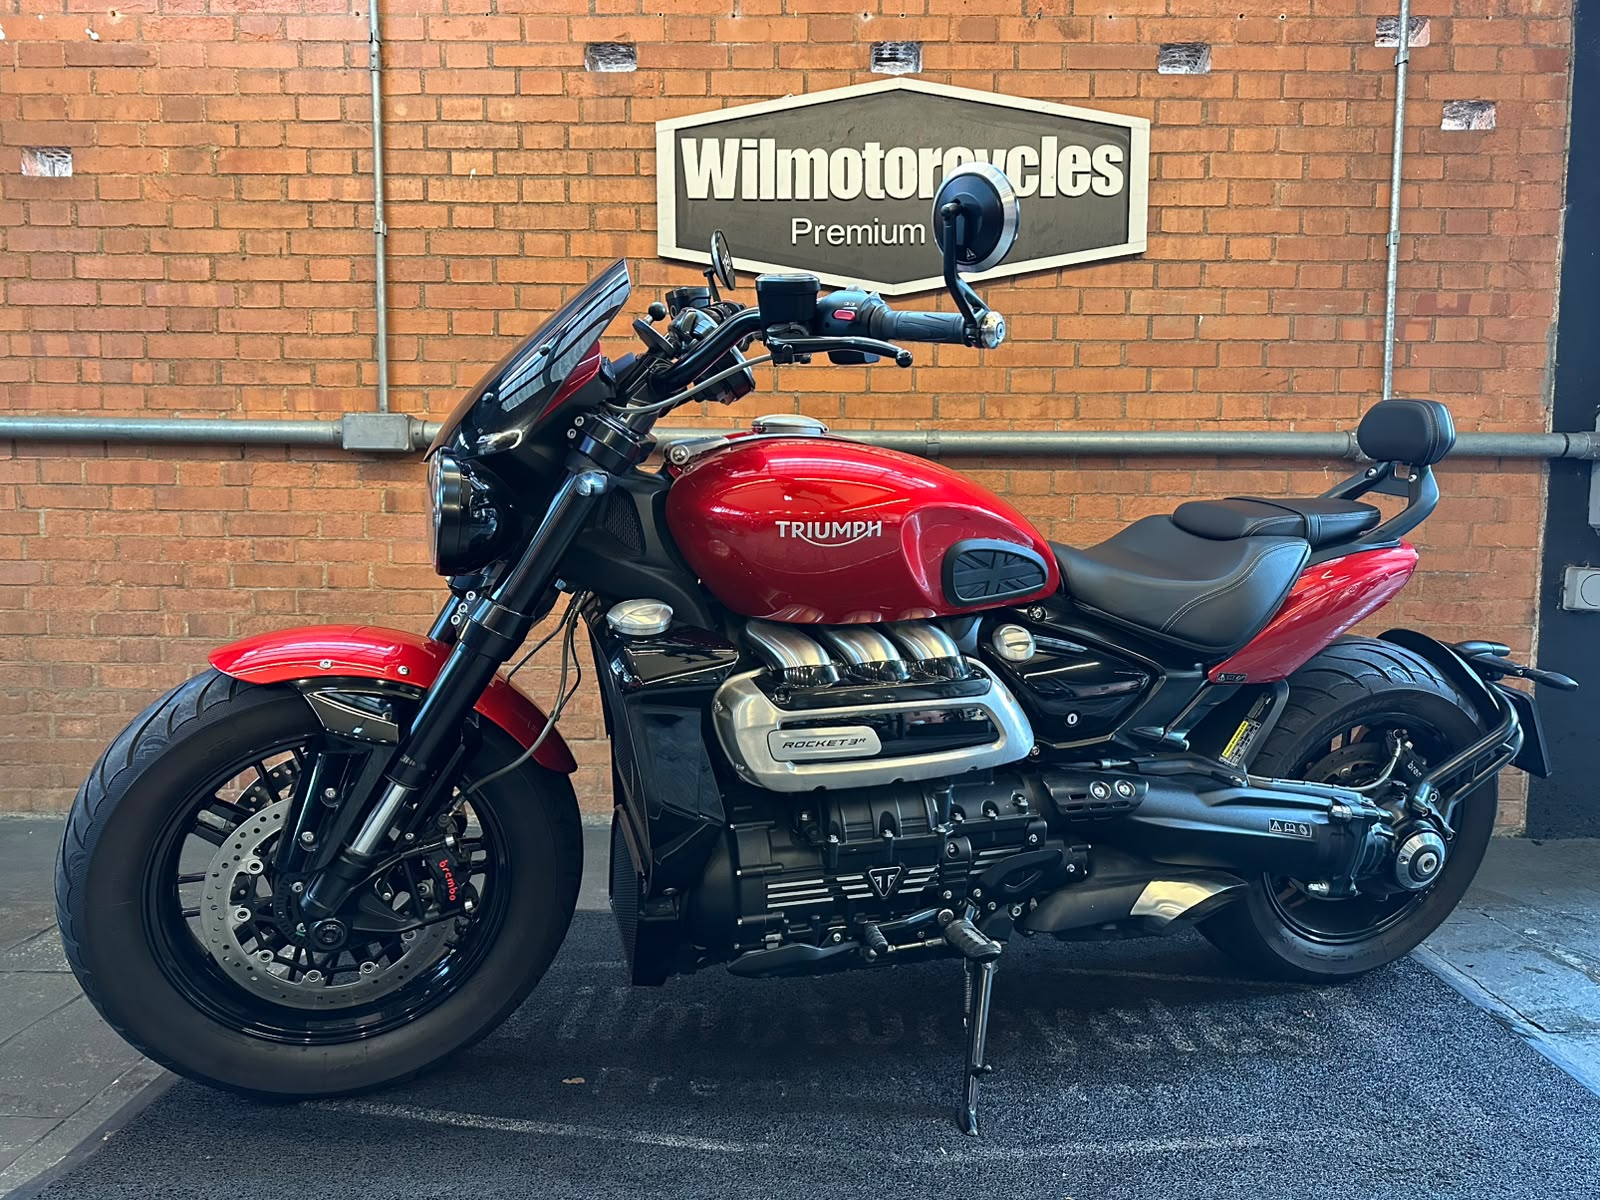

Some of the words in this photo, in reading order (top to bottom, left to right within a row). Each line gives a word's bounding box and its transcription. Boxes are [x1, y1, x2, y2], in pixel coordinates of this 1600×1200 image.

[681, 136, 1124, 200] Wilmotorcles
[791, 218, 925, 245] Premium
[775, 520, 882, 547] TRIUMPH
[439, 859, 458, 901] brembo
